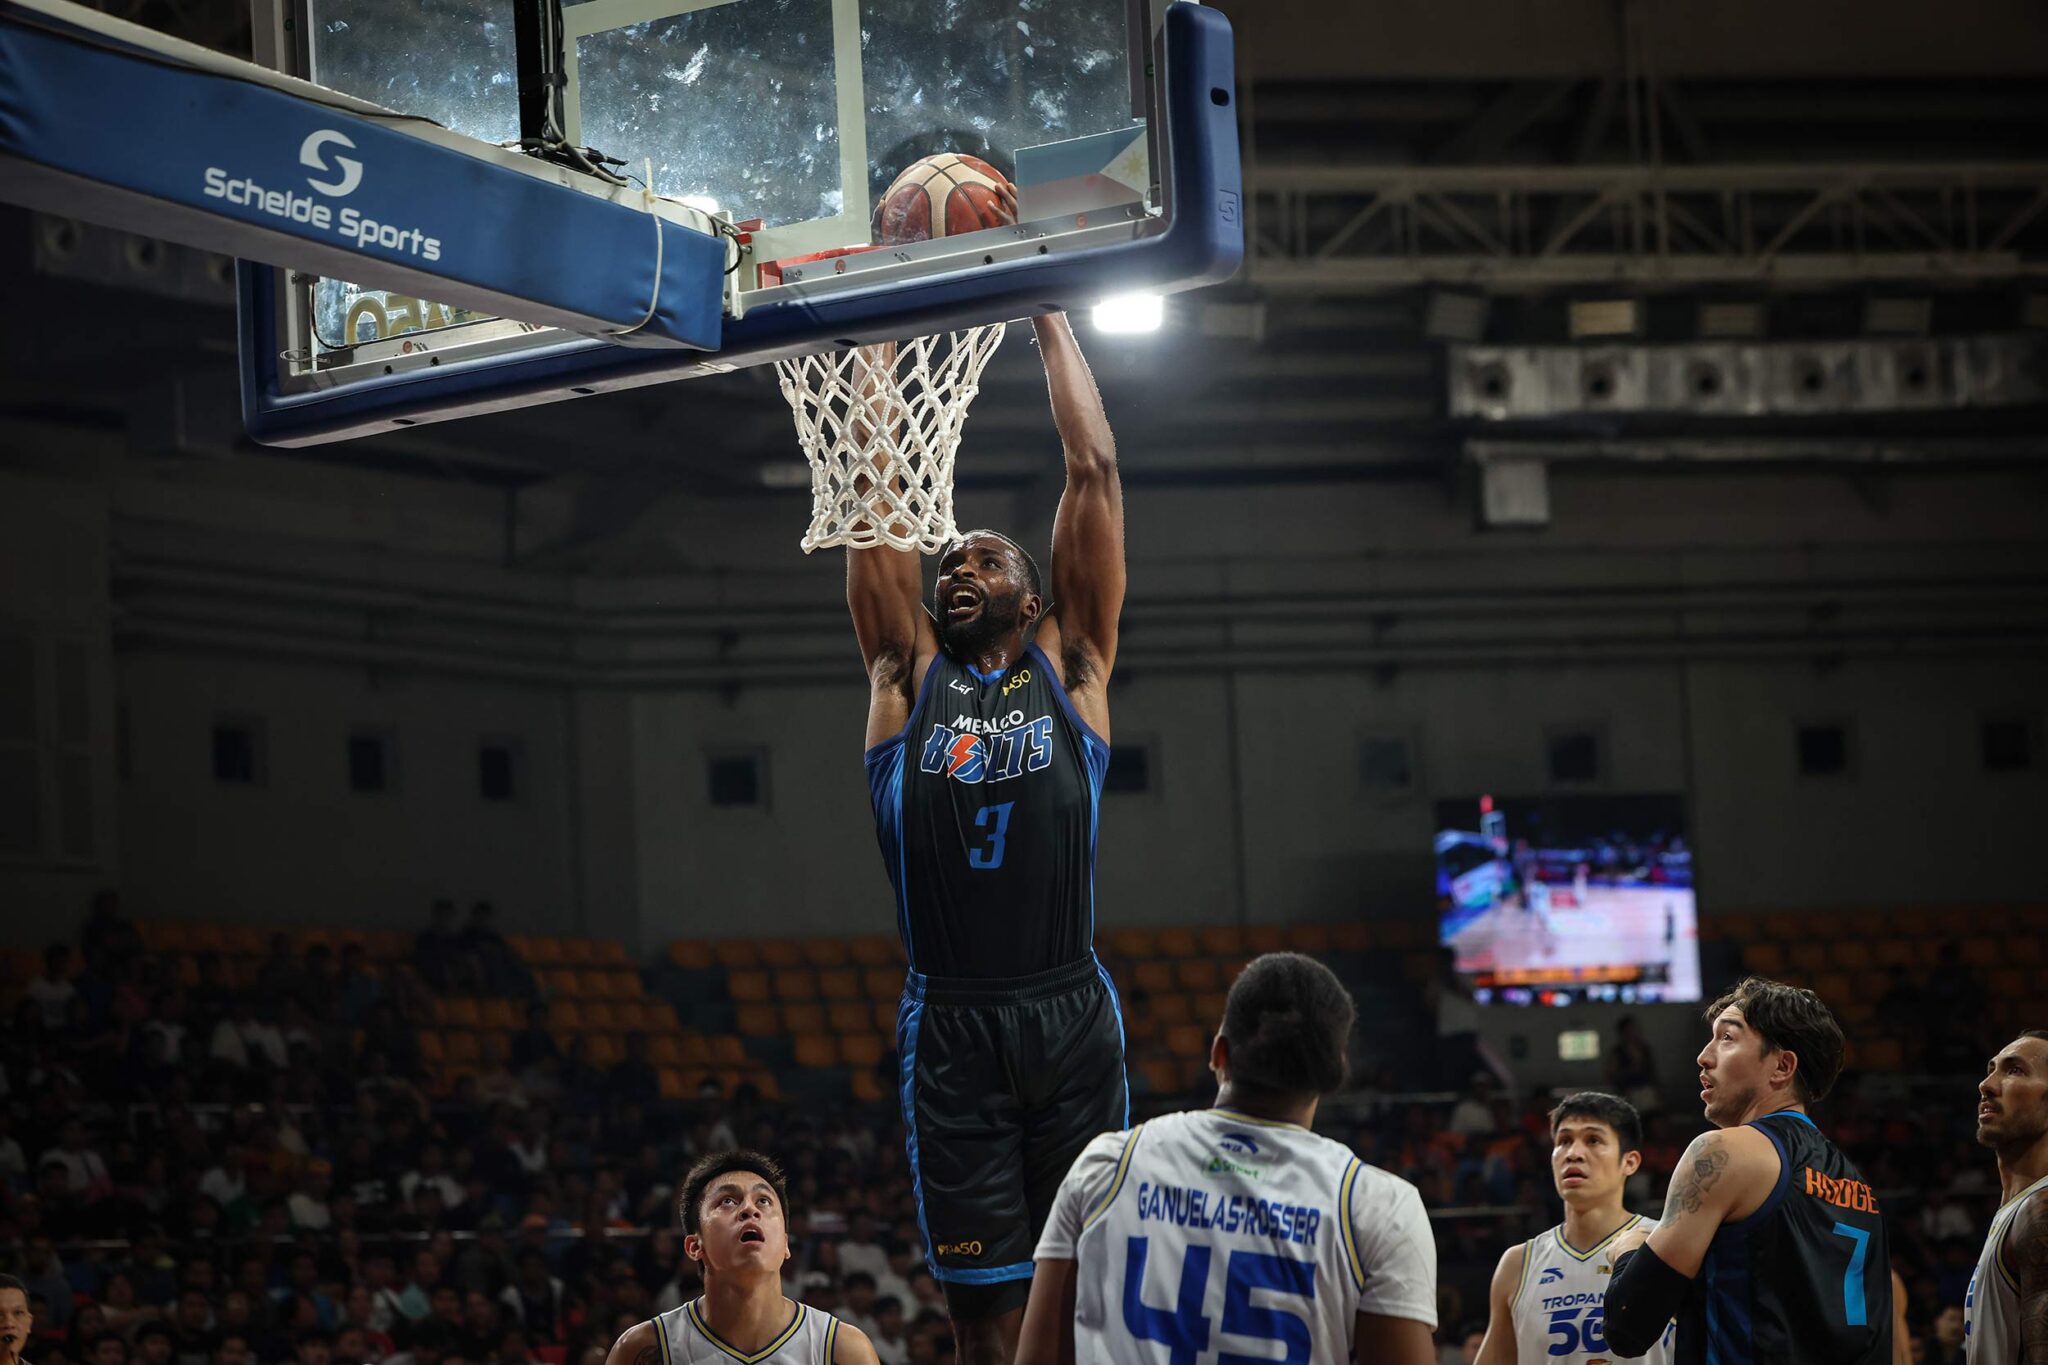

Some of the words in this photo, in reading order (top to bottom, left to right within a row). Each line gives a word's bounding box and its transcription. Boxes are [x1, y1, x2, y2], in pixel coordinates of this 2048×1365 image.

[203, 166, 332, 230] Schelde
[338, 208, 441, 261] Sports
[969, 800, 1016, 869] 3
[1138, 1182, 1321, 1246] GANUELAS-ROSSER
[1805, 1166, 1880, 1214] HODGE
[1122, 1236, 1317, 1365] 45
[1832, 1221, 1871, 1326] 7
